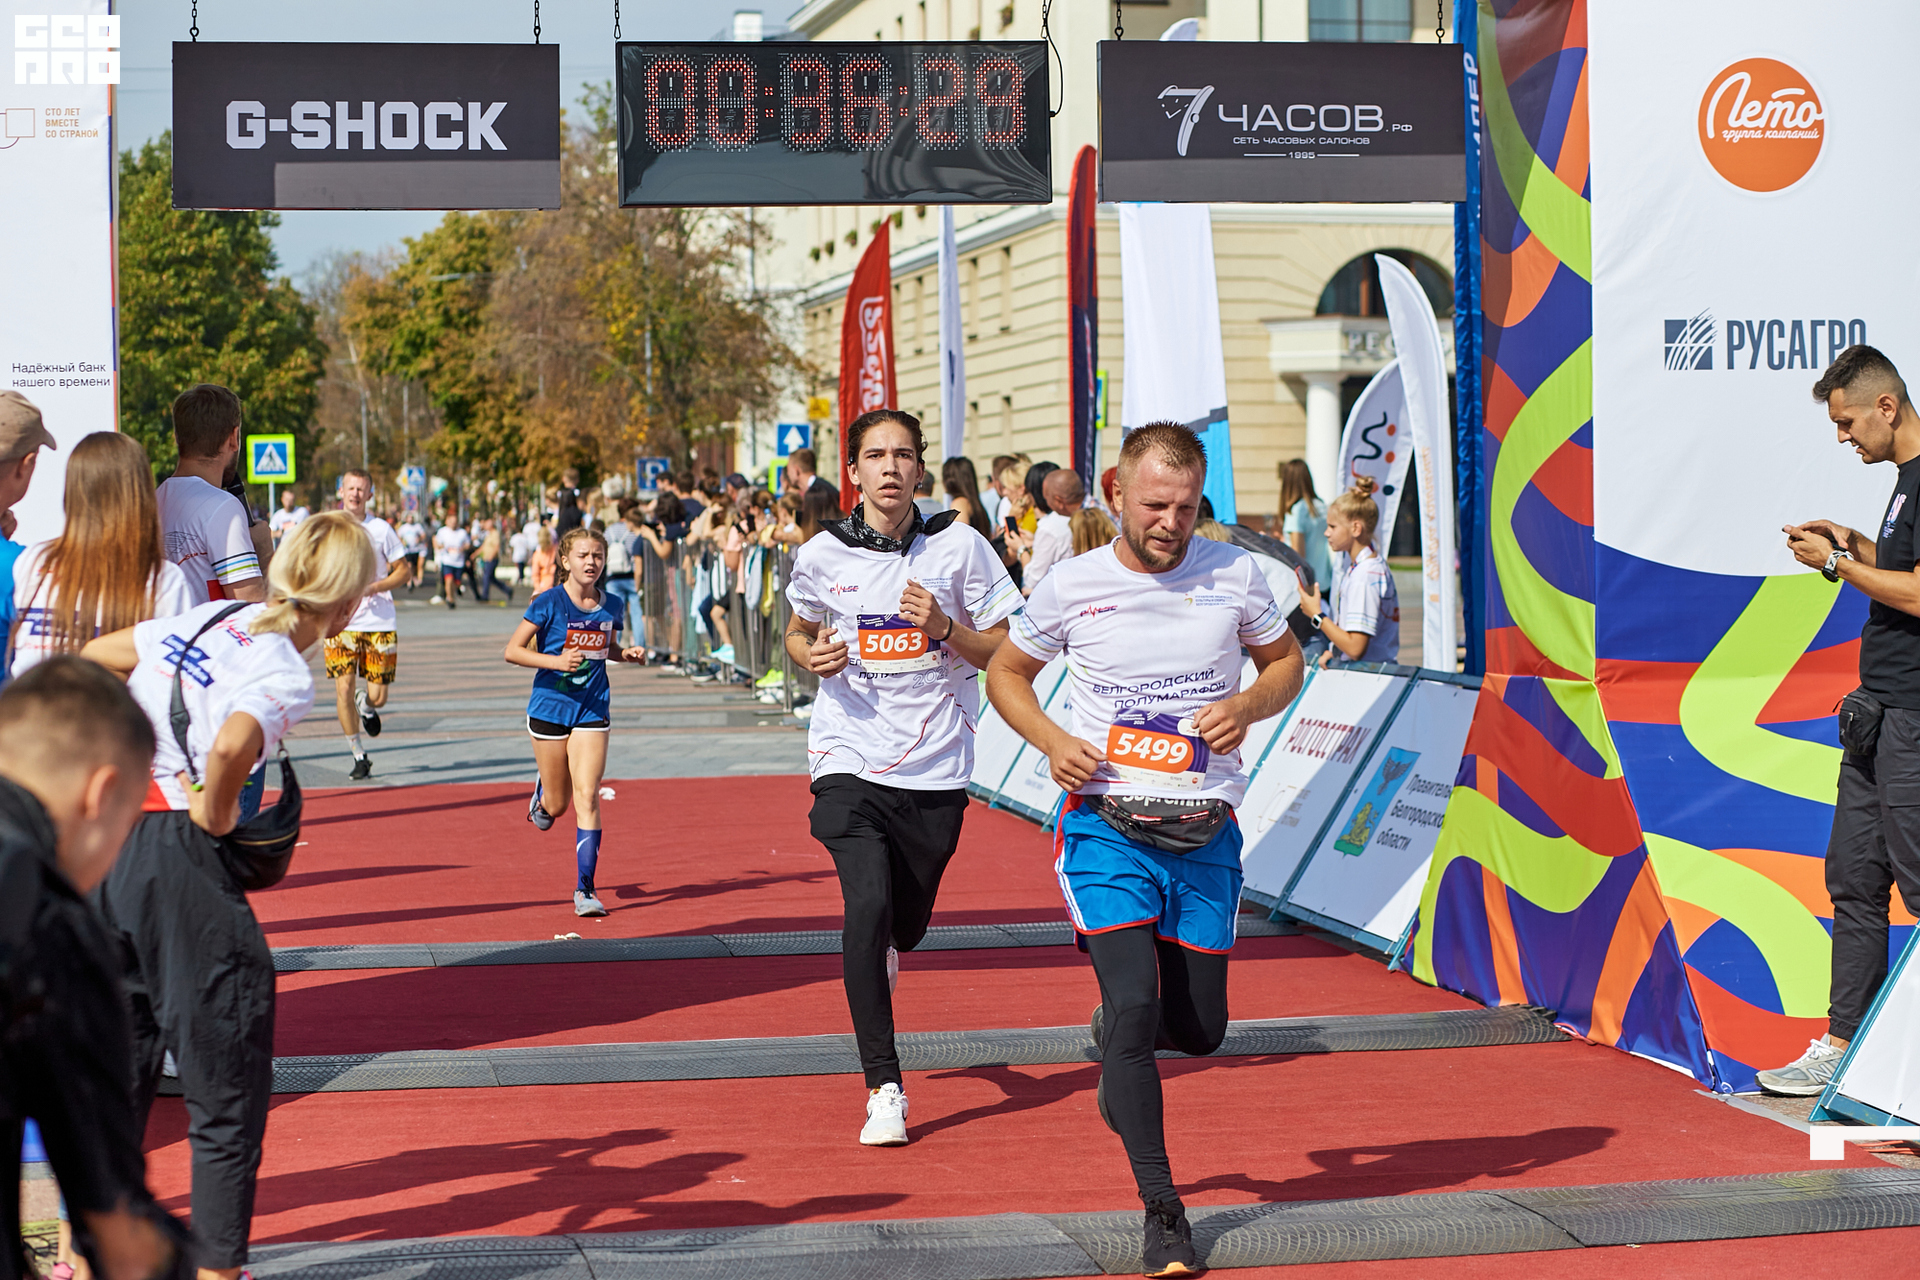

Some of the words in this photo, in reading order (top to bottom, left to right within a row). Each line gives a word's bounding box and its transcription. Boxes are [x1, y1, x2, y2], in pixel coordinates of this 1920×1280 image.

[45, 108, 61, 116] СТО
[64, 108, 81, 116] ЛЕТ
[1706, 71, 1824, 139] Лето
[45, 119, 79, 127] ВМЕСТЕ
[45, 130, 57, 138] СО
[60, 128, 98, 138] СТРАНОЙ
[226, 101, 508, 150] G-SHOCK
[1319, 137, 1370, 145] САЛОНОВ
[1722, 129, 1763, 143] группа
[1764, 128, 1820, 139] компаний
[1727, 318, 1866, 370] РУСАГРО
[12, 363, 75, 374] Надёжный
[79, 362, 106, 372] банк
[12, 379, 55, 387] нашего
[59, 378, 110, 389] времени
[569, 633, 605, 647] 5028
[864, 632, 923, 653] 5063
[1092, 667, 1215, 694] БЕЛГОРОДСКИЙ
[1114, 681, 1226, 709] ПОЛУМАРАФОН
[1113, 732, 1188, 764] 5499
[1283, 718, 1372, 764] РОСГОССТРАХ
[1376, 827, 1412, 851] области
